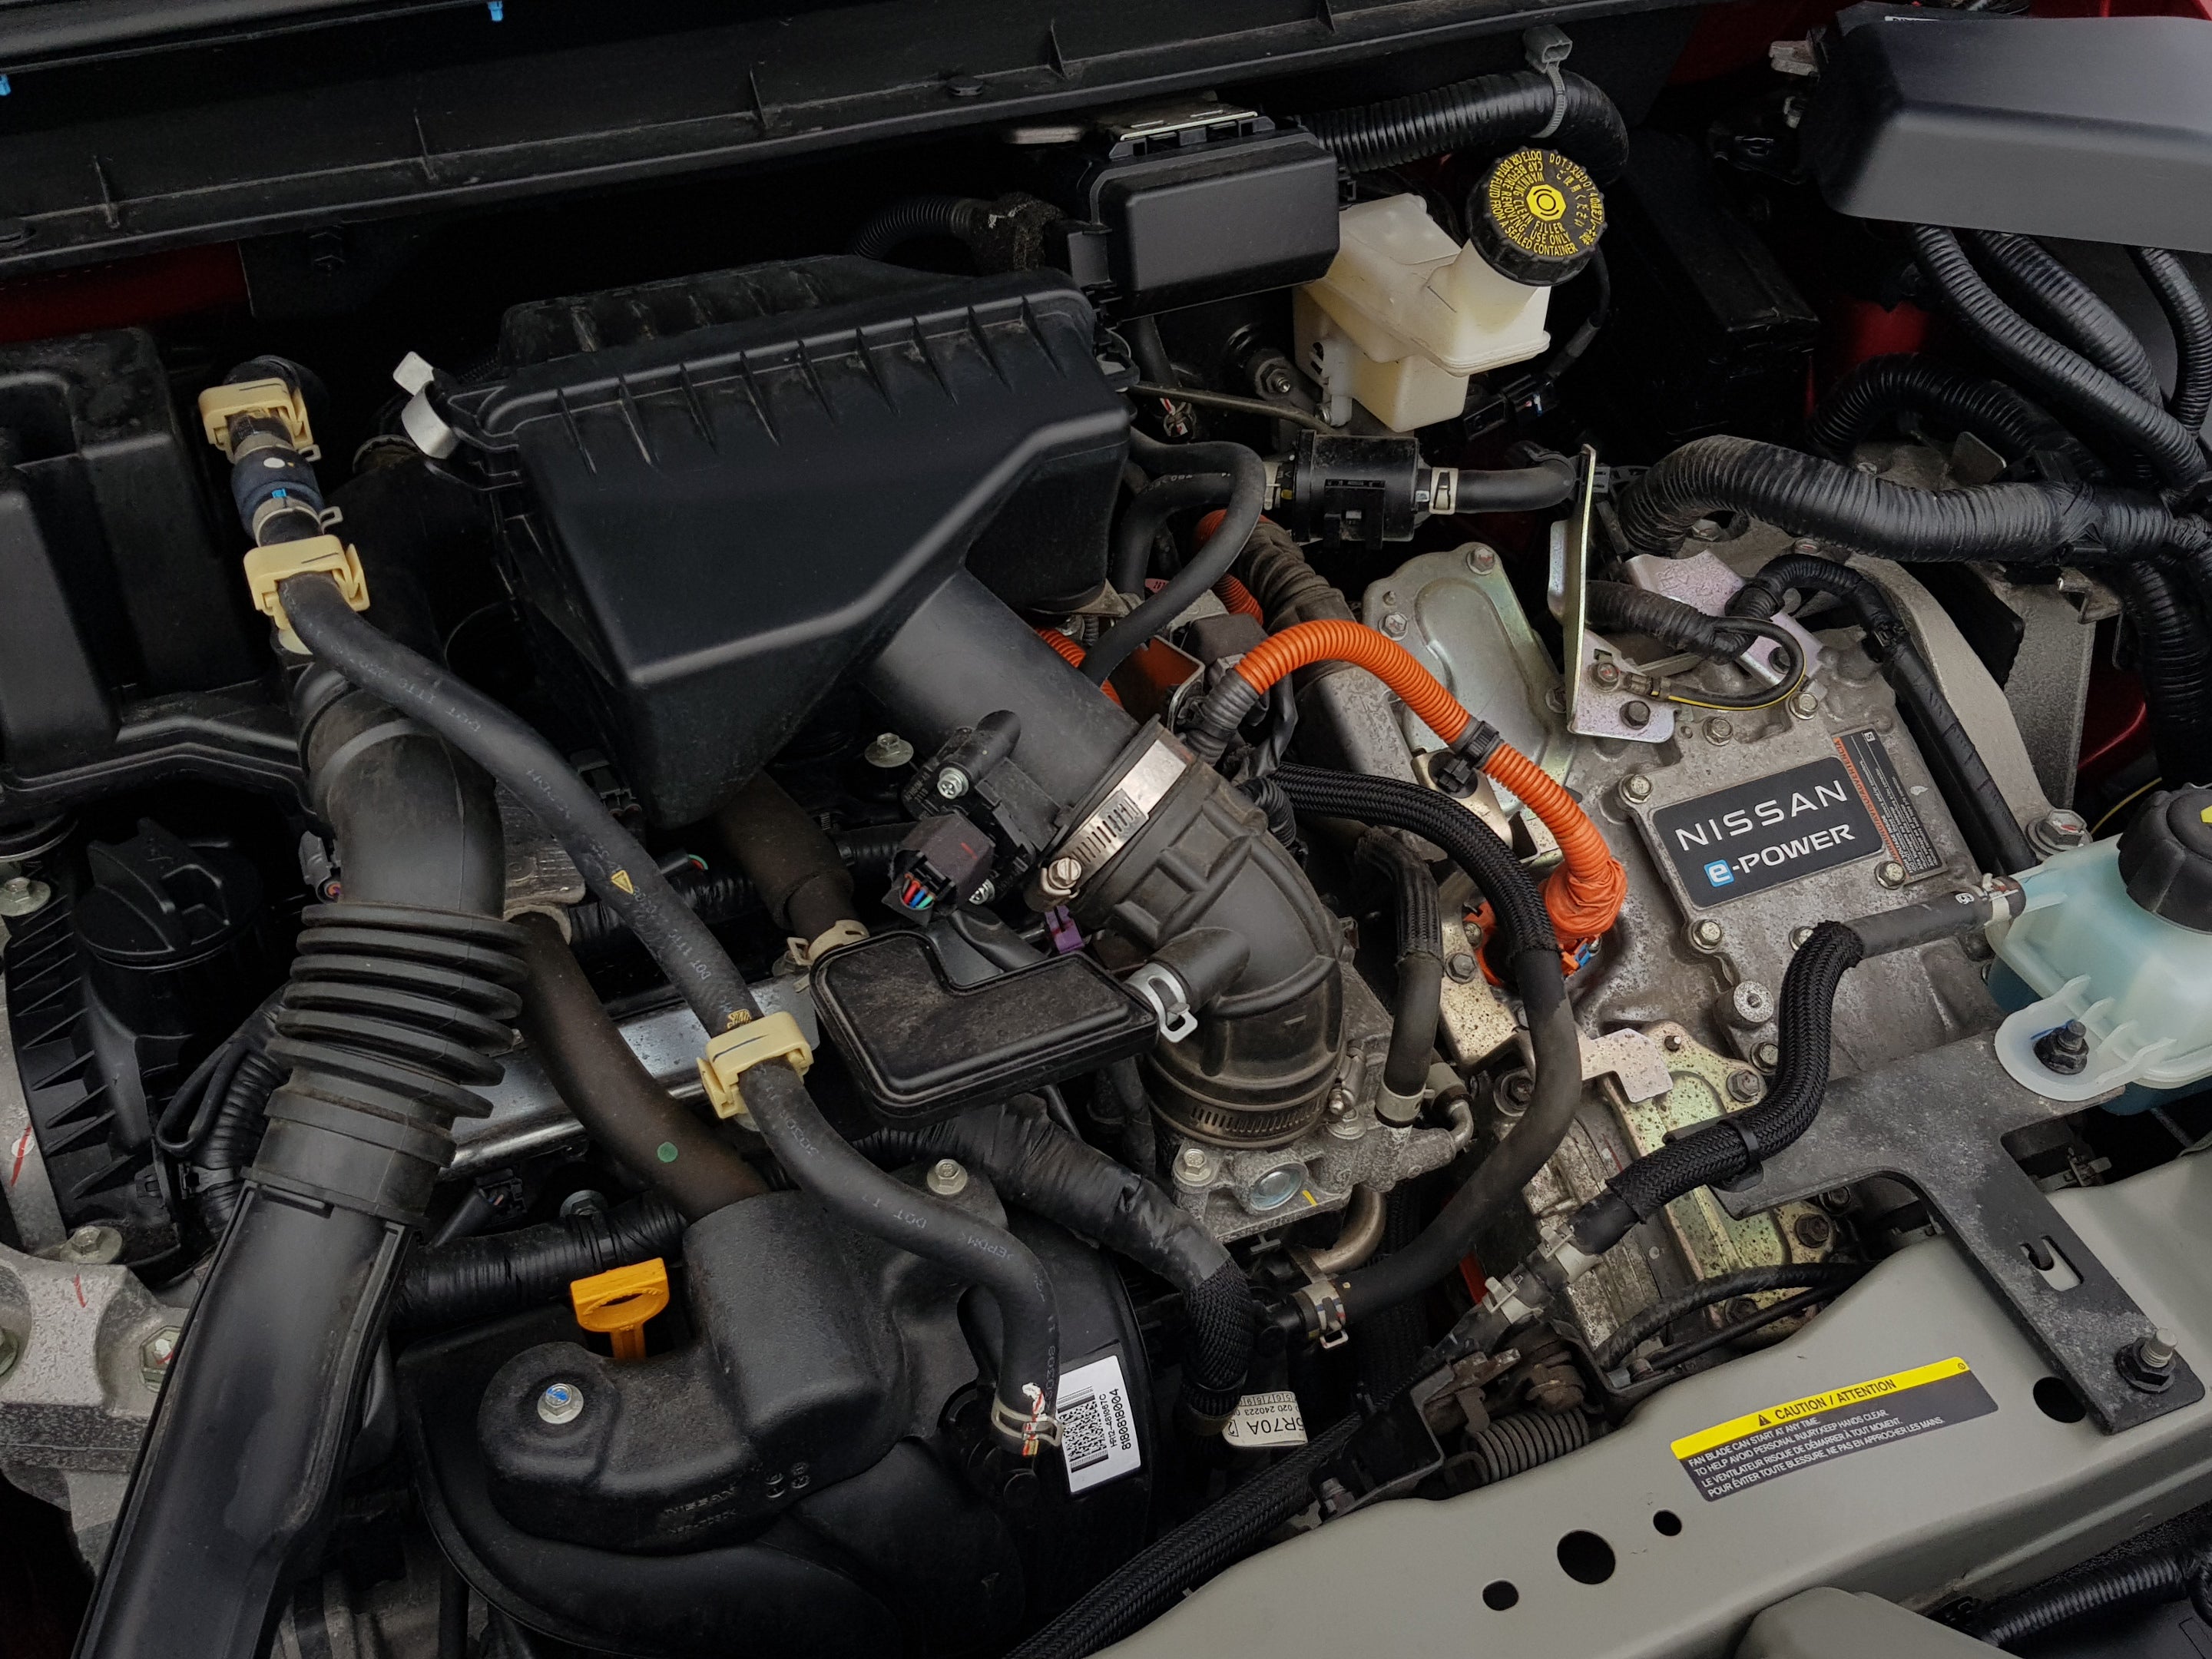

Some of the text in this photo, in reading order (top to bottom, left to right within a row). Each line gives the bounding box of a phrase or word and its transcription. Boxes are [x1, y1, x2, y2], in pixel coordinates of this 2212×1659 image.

[1494, 160, 1514, 178] DOT4
[1508, 154, 1522, 165] OR
[1521, 151, 1542, 162] DOT3
[1528, 161, 1543, 172] CAP
[1489, 175, 1502, 198] FLUID
[1502, 164, 1528, 190] BEFORE
[1490, 200, 1506, 221] FROM
[1513, 171, 1566, 234] WARNING CLEAN FILLER
[1556, 169, 1589, 227] ご使用ください
[1505, 226, 1533, 250] SEALED
[1530, 229, 1547, 243] USE
[1549, 232, 1571, 245] ONLY
[1533, 242, 1578, 256] CONTAINER
[1675, 780, 1848, 851] NISSAN
[1707, 823, 1856, 883] e-POWER
[1244, 1406, 1275, 1416] 240223
[1775, 1379, 1897, 1419] CAUTION / ATTENTION
[1109, 1388, 1131, 1450] 8180818004
[1688, 1455, 1706, 1467] FAN
[1705, 1445, 1733, 1461] BLADE
[1732, 1439, 1751, 1450] CAN
[1750, 1430, 1775, 1444] START
[1775, 1427, 1785, 1436] AT
[1785, 1422, 1801, 1433] ANY
[1694, 1467, 1707, 1476] TO
[1707, 1459, 1728, 1472] HELP
[1729, 1449, 1753, 1465] AVOID
[1753, 1436, 1796, 1455] PERSONAL
[1838, 1416, 1864, 1429] HANDS
[1701, 1418, 1903, 1488] LE VENTILATEUR RISQUE DE DÉMARRER À TOUT MOMENT.
[1707, 1482, 1733, 1497] POUR
[1731, 1472, 1760, 1488] ÉVITER
[1759, 1462, 1787, 1476] TOUTE
[1826, 1446, 1839, 1455] NE
[1836, 1442, 1854, 1452] PAS
[1852, 1439, 1866, 1448] EN
[1863, 1426, 1907, 1445] APPROCHER
[1906, 1422, 1922, 1432] LES
